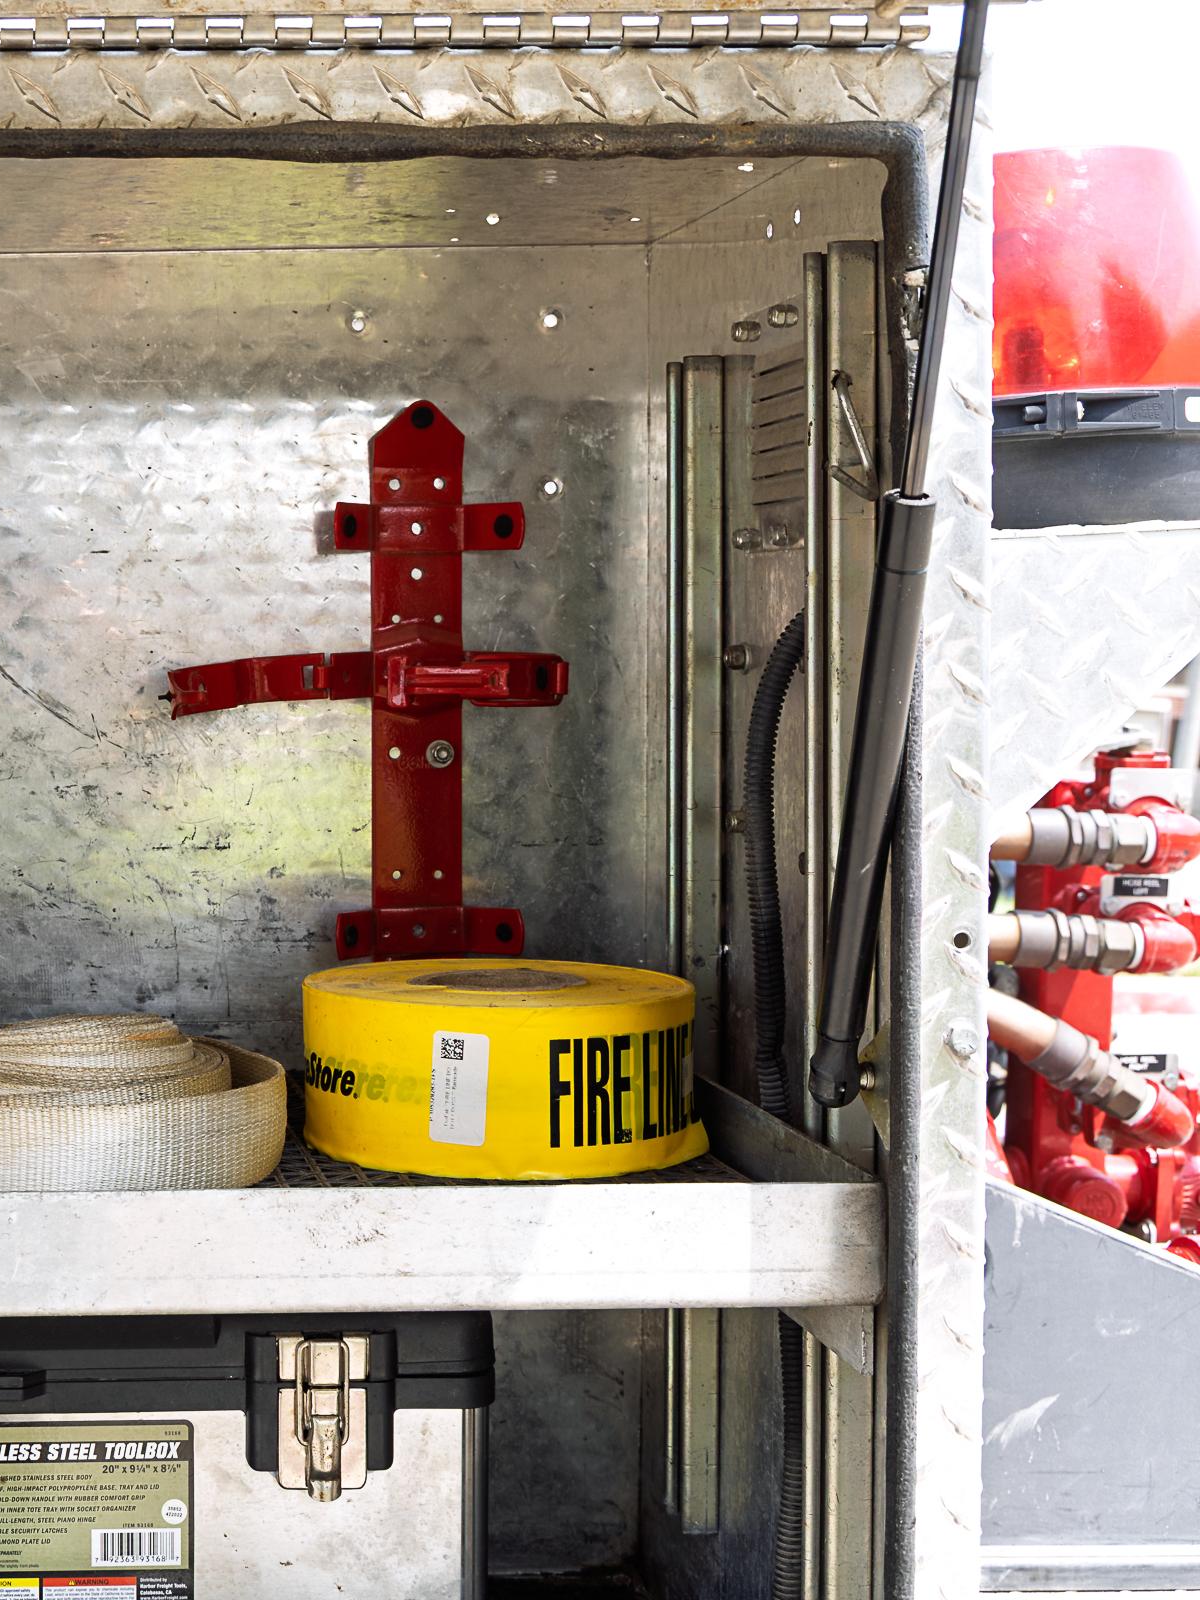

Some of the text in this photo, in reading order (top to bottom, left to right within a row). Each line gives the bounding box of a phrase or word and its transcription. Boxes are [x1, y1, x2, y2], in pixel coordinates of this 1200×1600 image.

[550, 1034, 632, 1148] FIRE
[47, 1443, 98, 1461] STEEL
[104, 1441, 181, 1460] TOOLBOX
[102, 1464, 119, 1474] 20"
[109, 1555, 136, 1563] 92363
